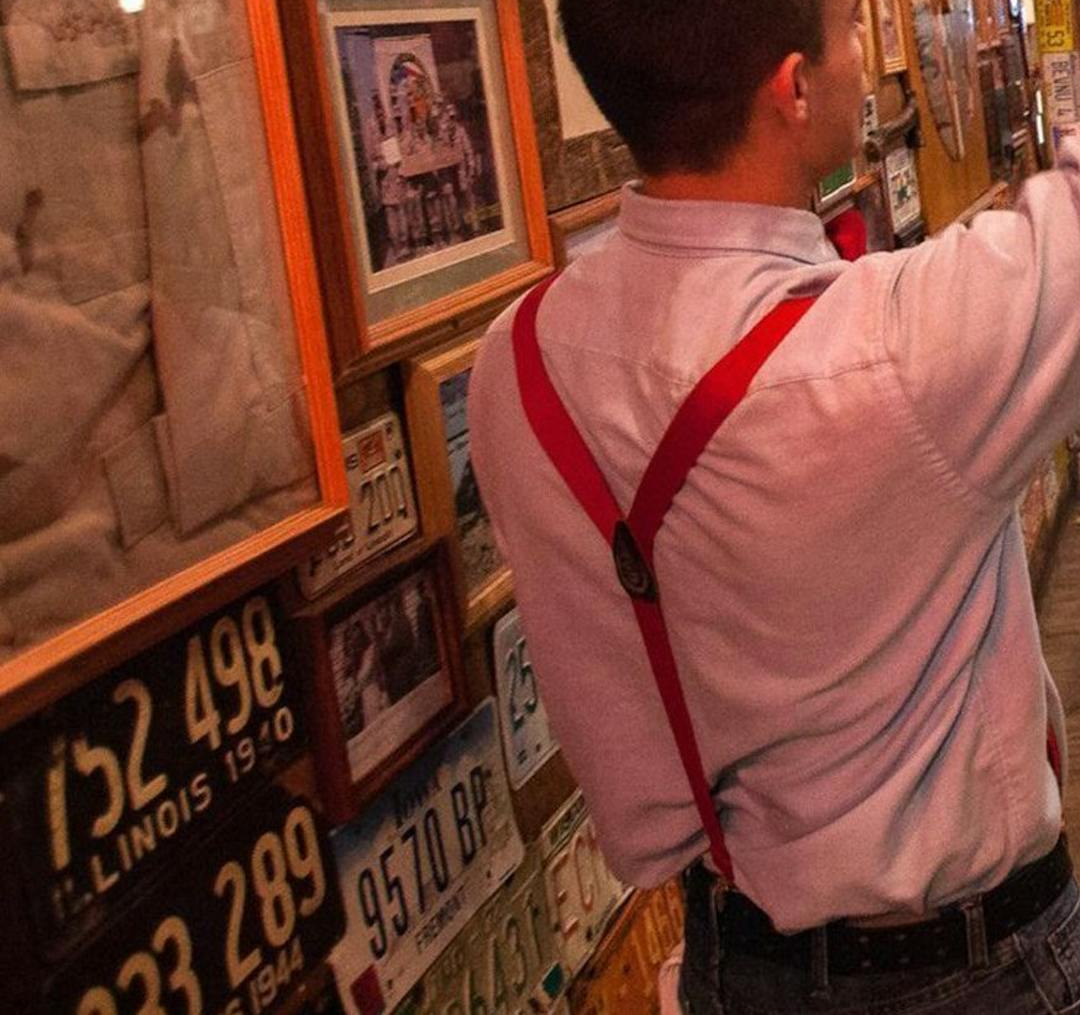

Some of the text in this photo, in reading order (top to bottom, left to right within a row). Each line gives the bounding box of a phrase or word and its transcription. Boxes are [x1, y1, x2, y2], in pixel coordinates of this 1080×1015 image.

[184, 595, 284, 751] 498
[213, 805, 327, 991] 289
[357, 764, 490, 961] 9570 BP
